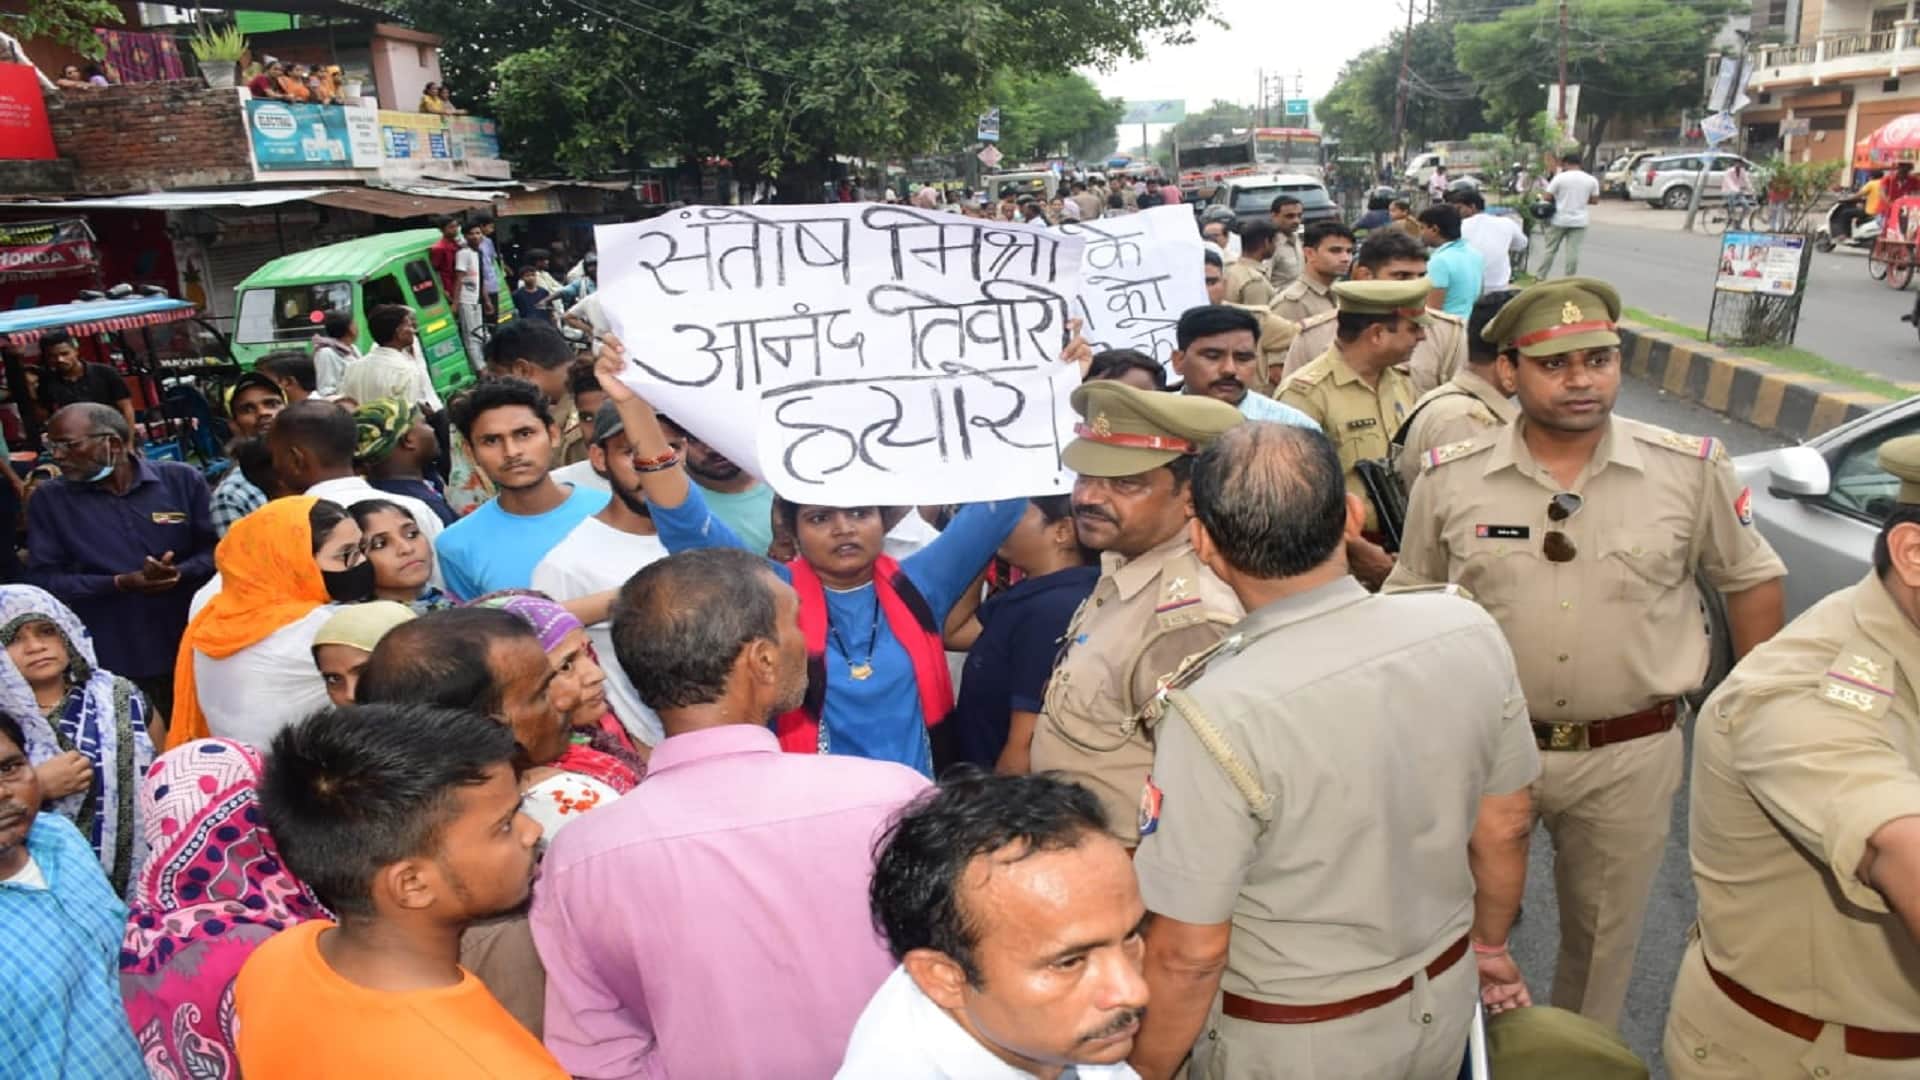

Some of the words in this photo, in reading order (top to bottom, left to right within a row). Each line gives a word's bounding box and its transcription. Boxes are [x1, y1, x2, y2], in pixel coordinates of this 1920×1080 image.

[638, 207, 851, 295] संतोष
[861, 205, 1060, 282] मिश्रा
[632, 303, 866, 391] आनंद
